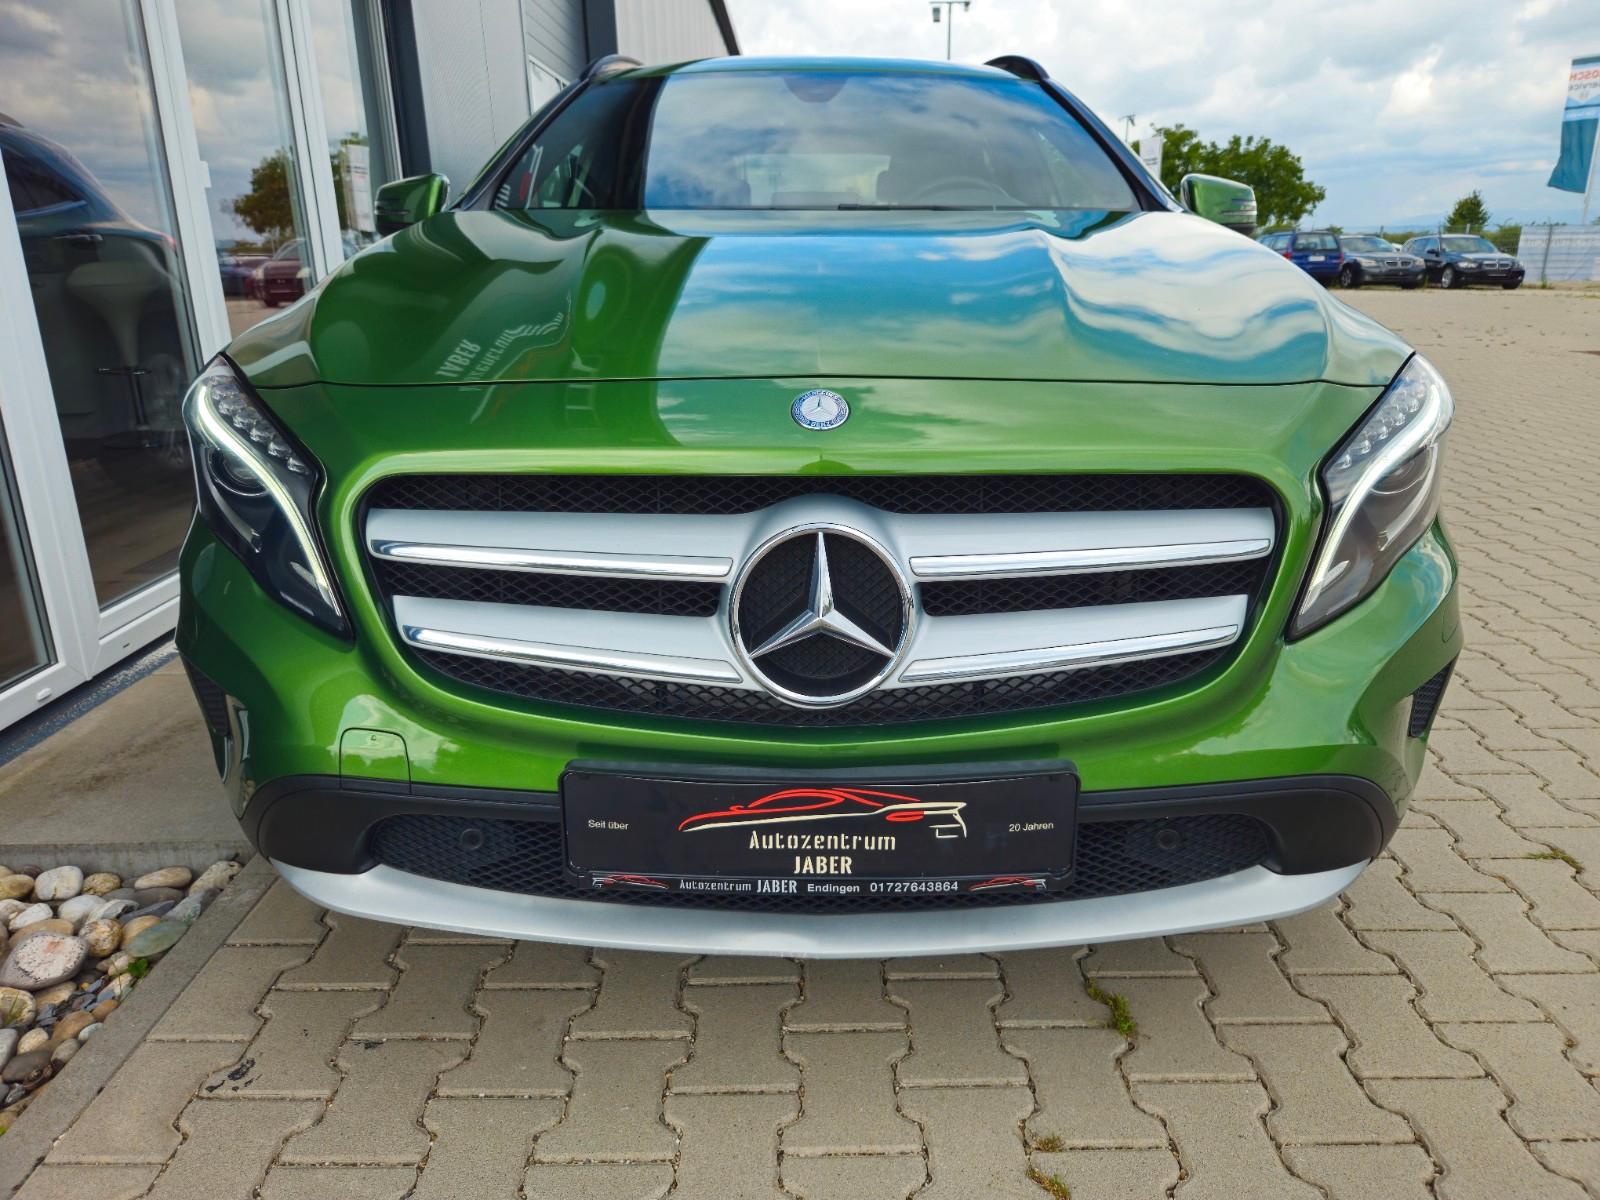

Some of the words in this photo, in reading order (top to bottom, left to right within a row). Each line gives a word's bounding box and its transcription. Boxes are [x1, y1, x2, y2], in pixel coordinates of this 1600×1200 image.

[588, 819, 606, 829] Seit
[608, 821, 629, 830] über
[1008, 823, 1021, 832] 20
[1022, 822, 1054, 831] Jahren
[749, 830, 896, 850] Autozentrum
[793, 856, 853, 875] JABER
[679, 879, 752, 892] Autozentrum
[756, 879, 798, 893] JABER
[807, 883, 860, 894] Endingen
[869, 881, 959, 893] 01727643864
